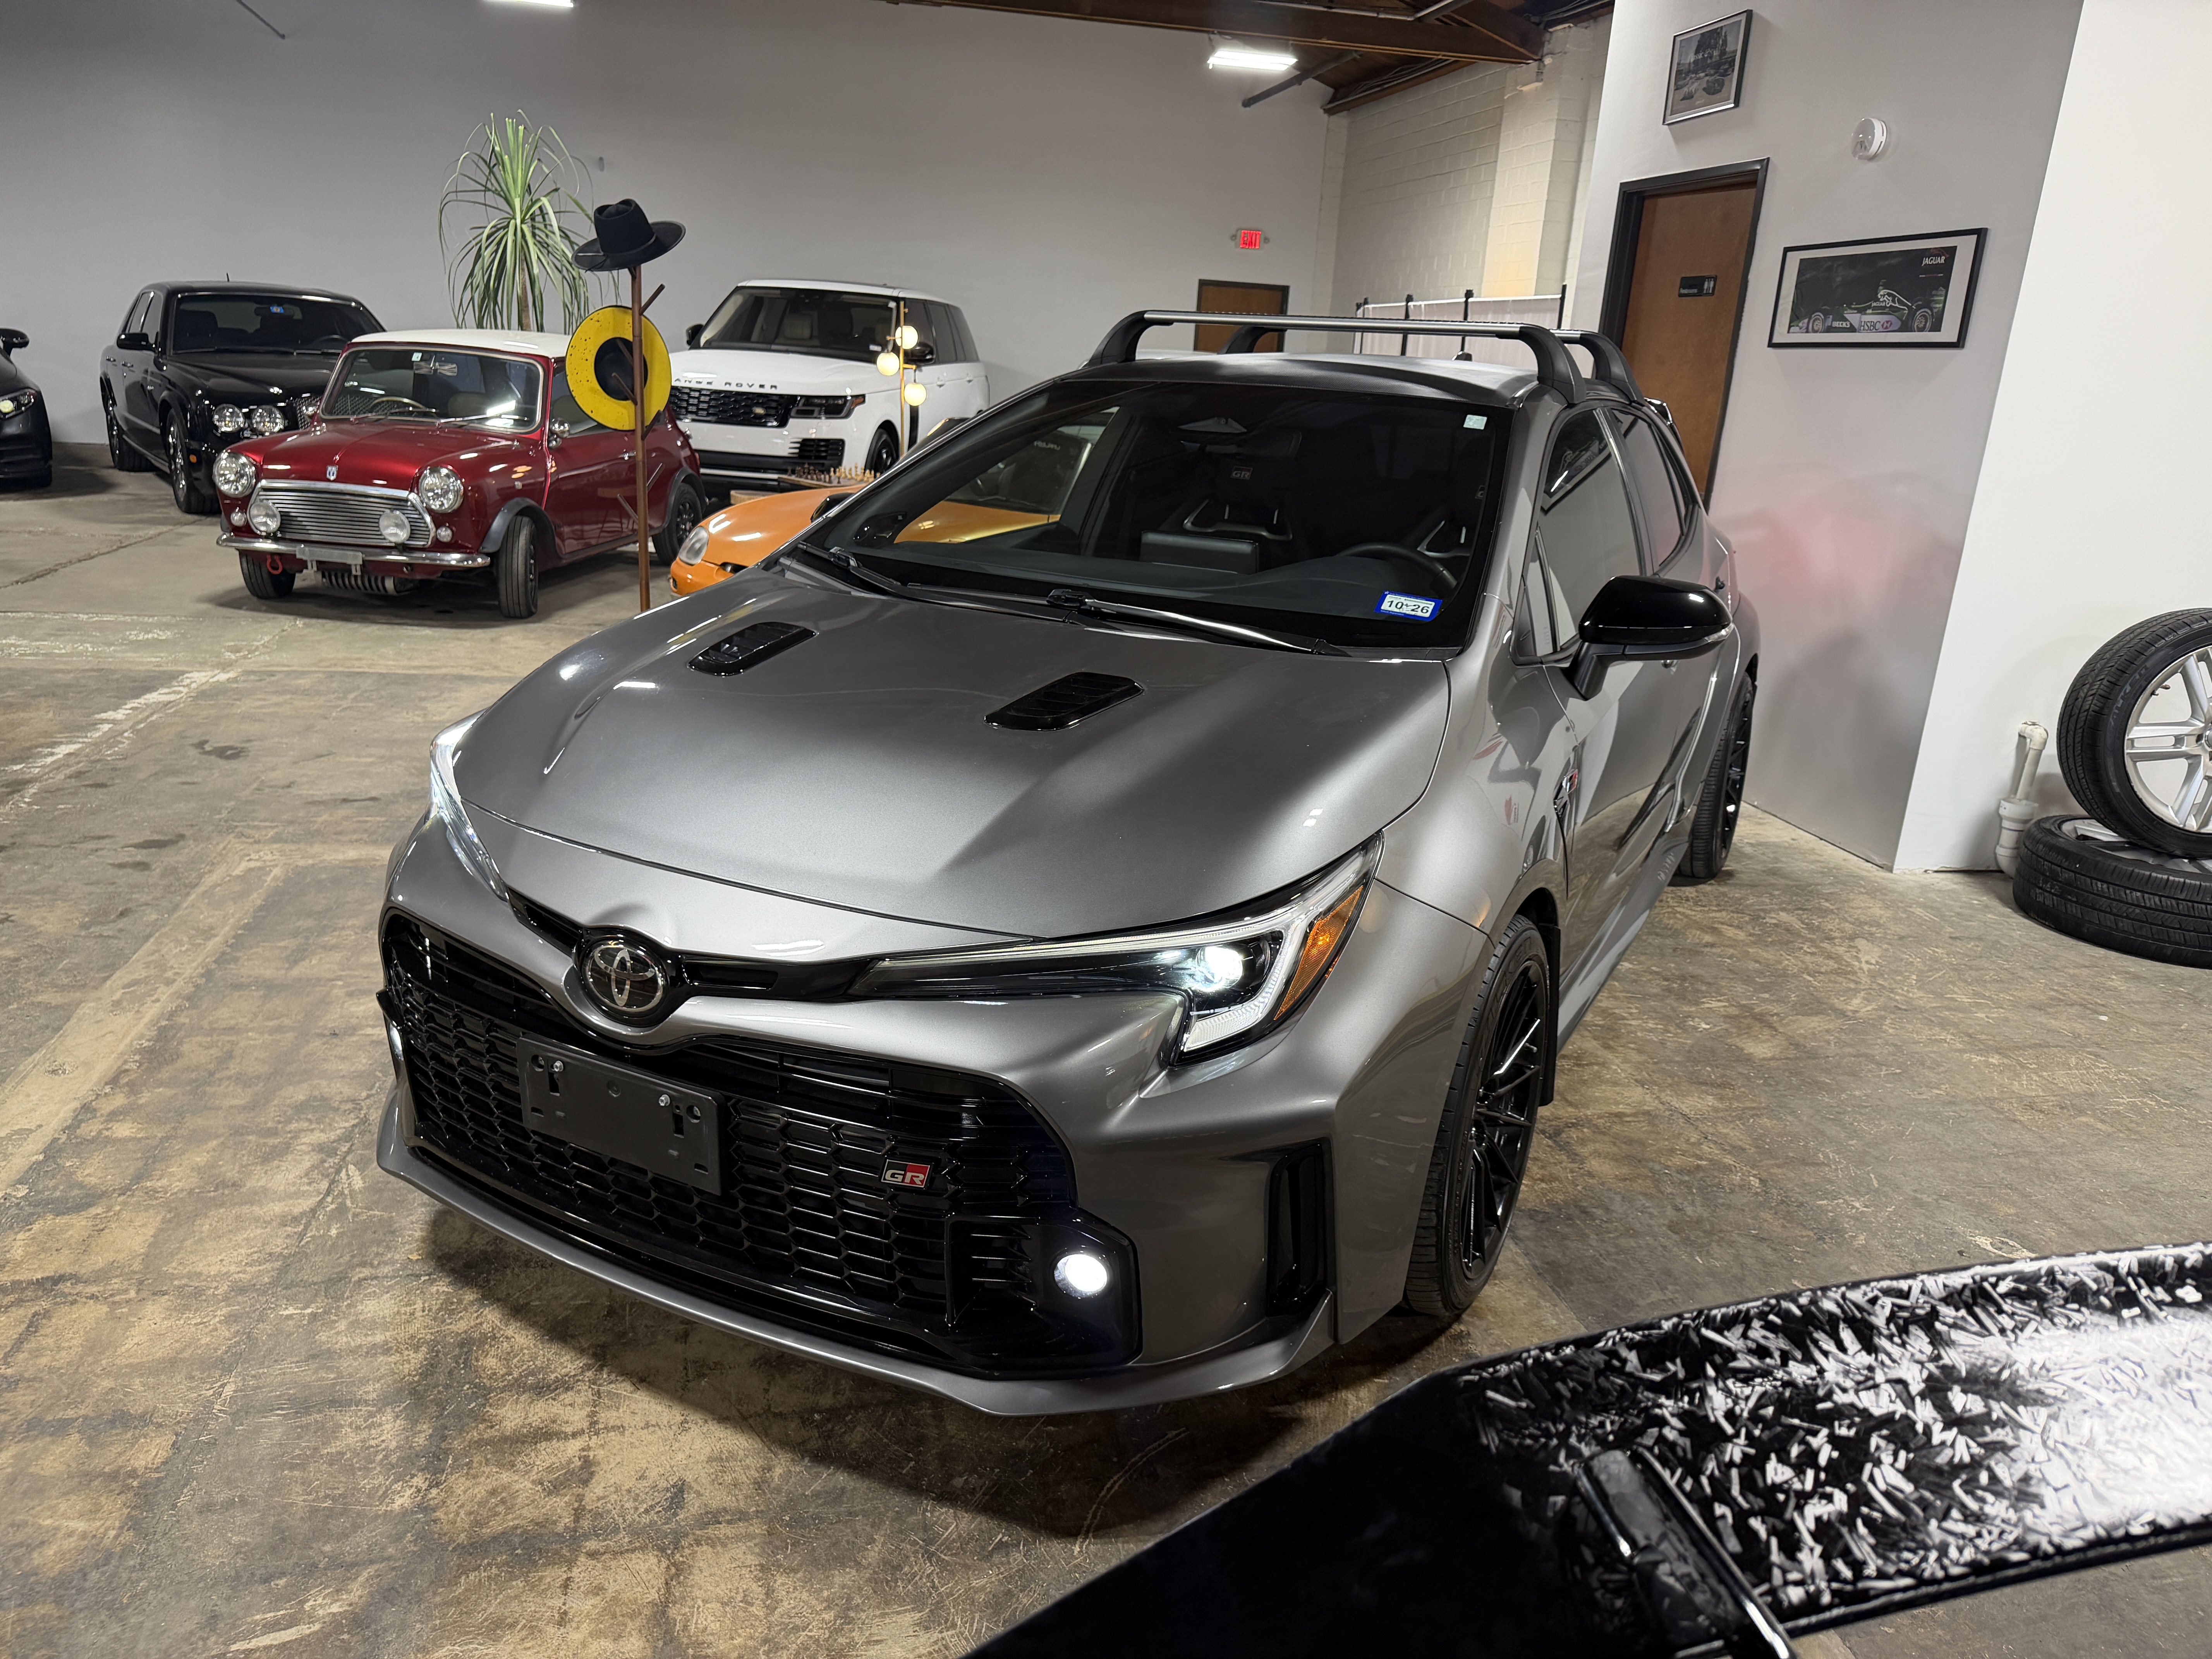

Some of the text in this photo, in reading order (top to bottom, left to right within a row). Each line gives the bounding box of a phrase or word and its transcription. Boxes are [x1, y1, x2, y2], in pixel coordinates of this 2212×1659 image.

[1240, 230, 1261, 249] EXIT
[1922, 256, 1945, 266] JAGUAR
[1860, 321, 1881, 331] HSBC
[724, 381, 778, 390] ROVER
[1233, 471, 1250, 479] GR
[1387, 600, 1404, 610] 10
[885, 1170, 925, 1185] GR
